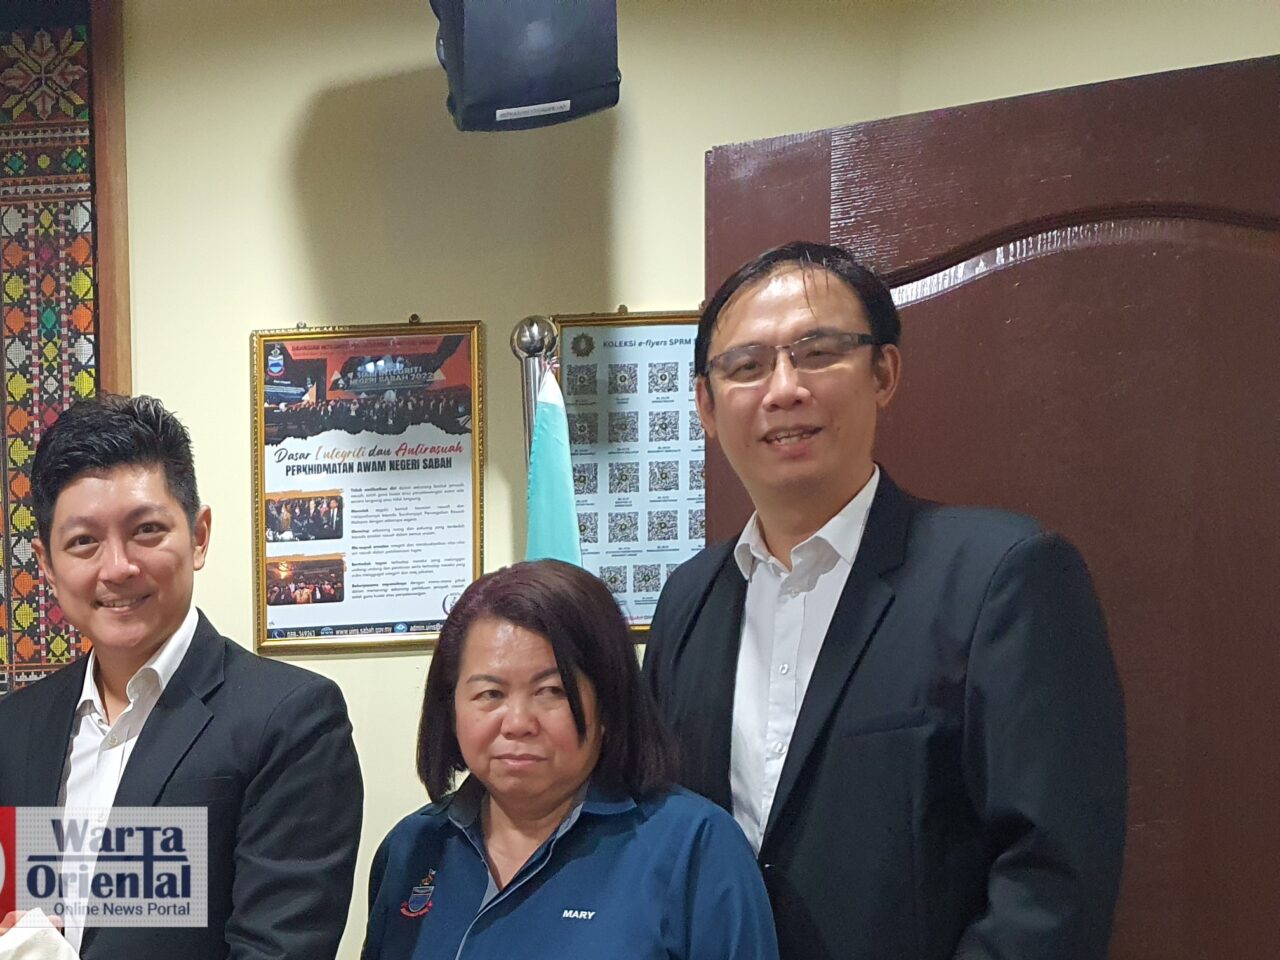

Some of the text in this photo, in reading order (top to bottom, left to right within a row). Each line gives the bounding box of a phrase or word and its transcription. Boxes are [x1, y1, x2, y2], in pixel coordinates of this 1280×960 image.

[669, 338, 692, 346] SPRM
[274, 447, 311, 463] Dasar
[368, 445, 392, 457] dan
[394, 441, 464, 457] Antirasuah
[285, 456, 452, 476] PERKHIDMATAN AWAM NEGERI SABAH
[562, 909, 595, 920] MARY
